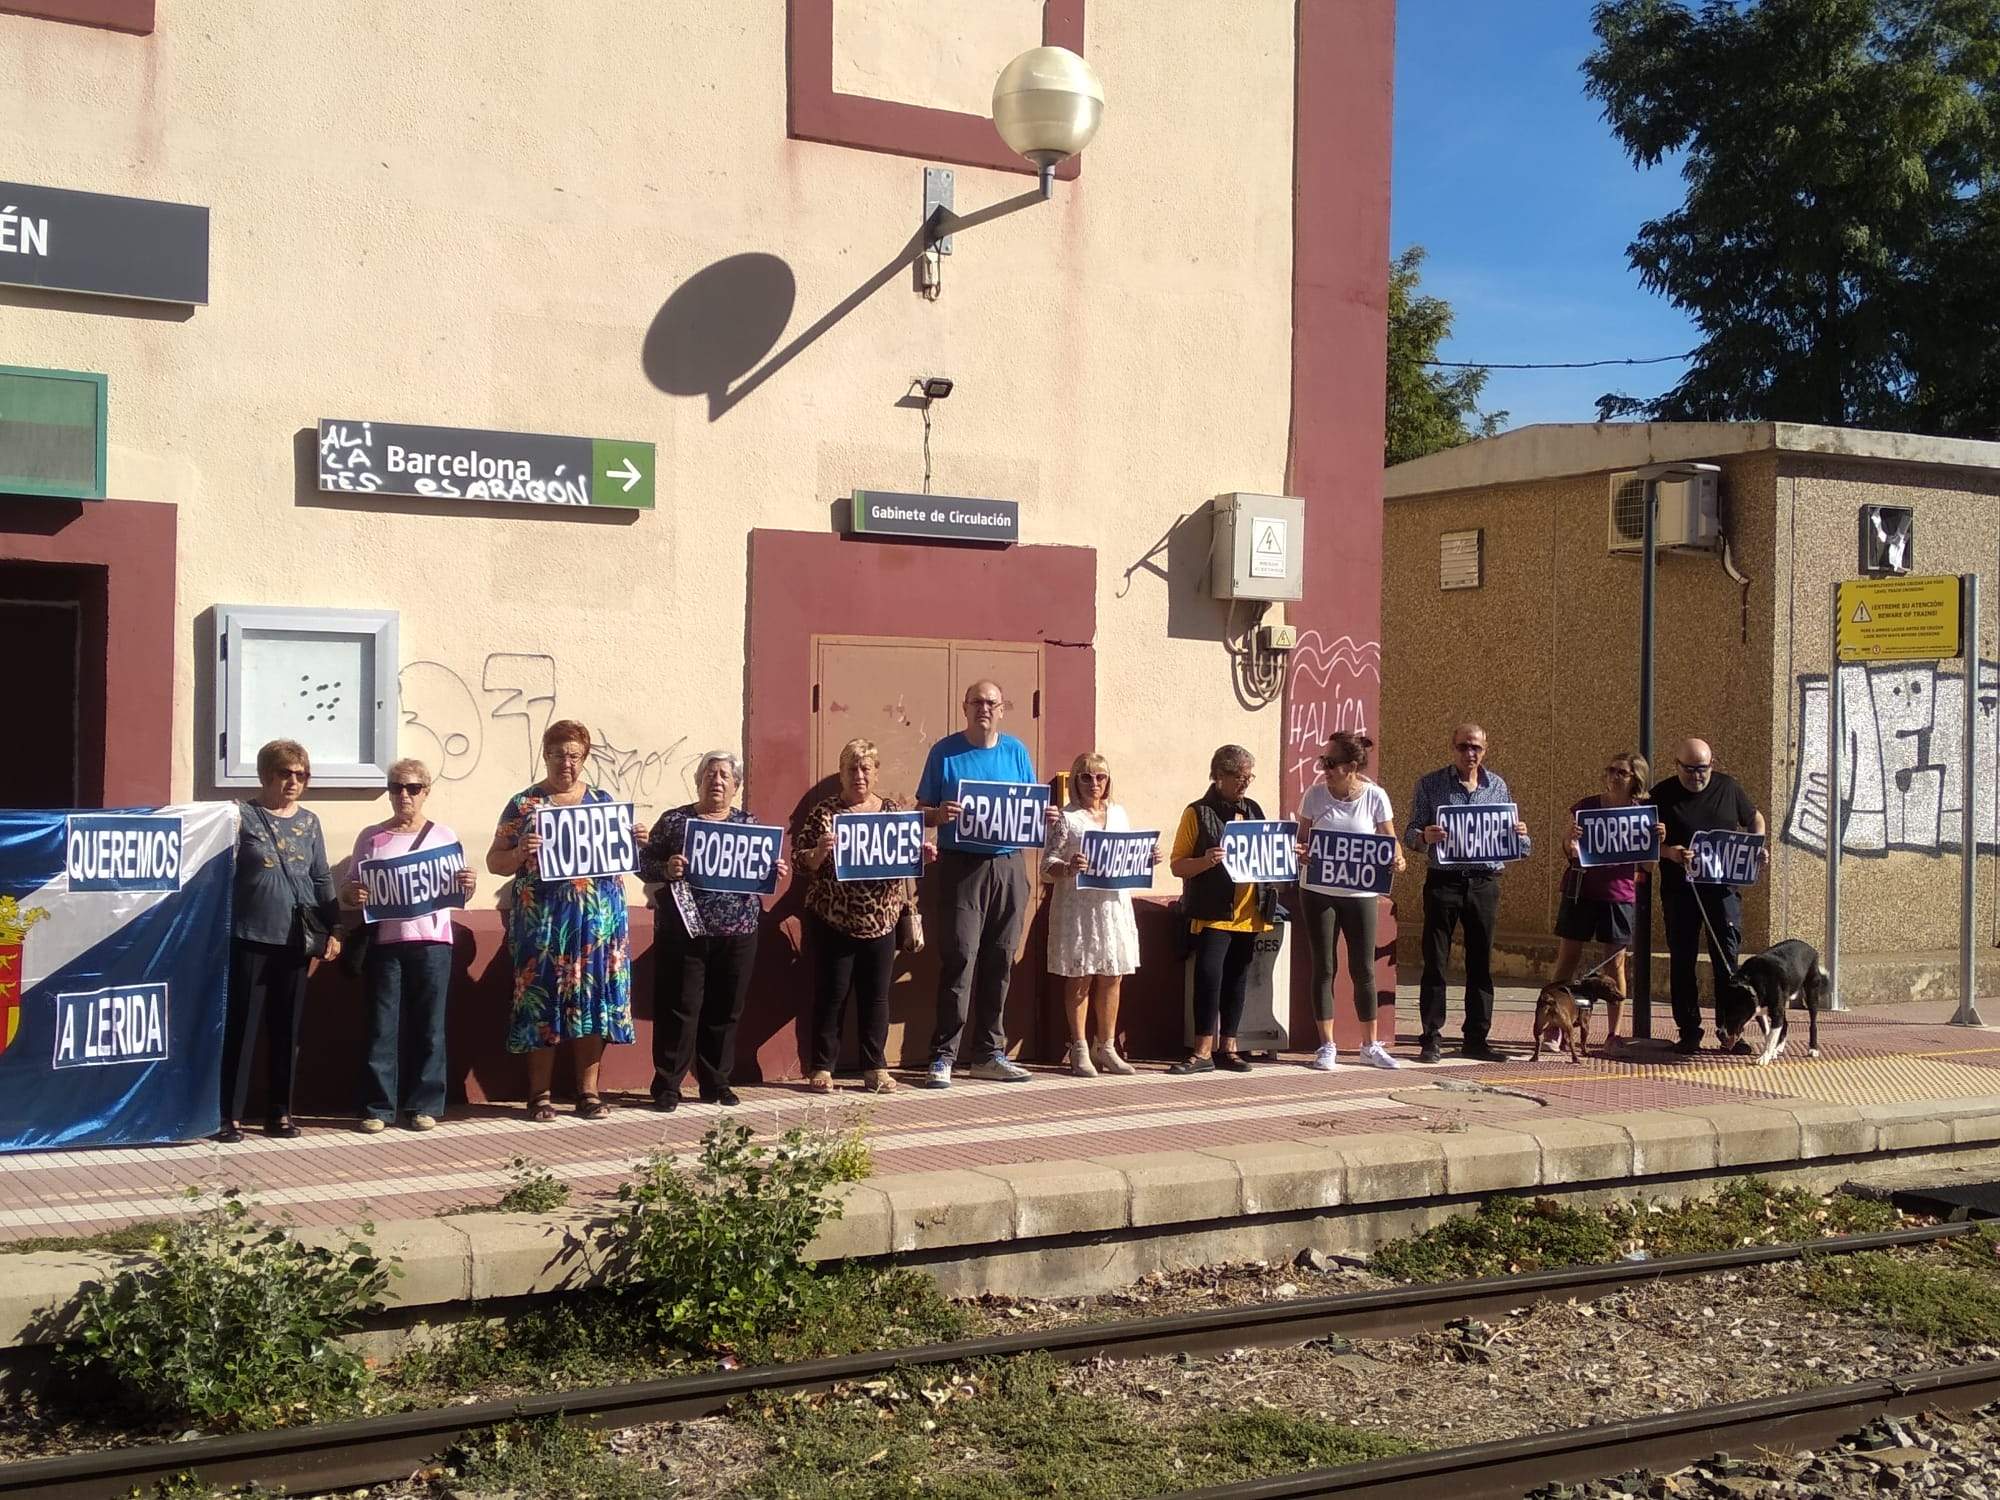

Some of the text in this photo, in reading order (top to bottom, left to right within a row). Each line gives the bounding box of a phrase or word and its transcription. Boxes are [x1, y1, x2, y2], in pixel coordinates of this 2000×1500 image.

[387, 444, 531, 481] Barcelona
[871, 505, 1011, 527] Gabinete de Circulación
[959, 786, 1047, 843] GRAÑÉN
[1439, 811, 1517, 858] SANGARREN
[1583, 813, 1651, 854] TORRES
[68, 830, 180, 882] QUEREMOS
[540, 804, 634, 877] ROBRES
[689, 830, 773, 881] ROBRES
[837, 821, 922, 867] PIRACES
[1083, 837, 1157, 878] ALCUBIERRE
[1223, 823, 1297, 877] GRAÑÉN
[1308, 833, 1393, 865] ALBERO
[1688, 835, 1762, 881] GRAÑÉN
[1320, 860, 1376, 889] BAJO
[57, 993, 163, 1061] A LERIDA
